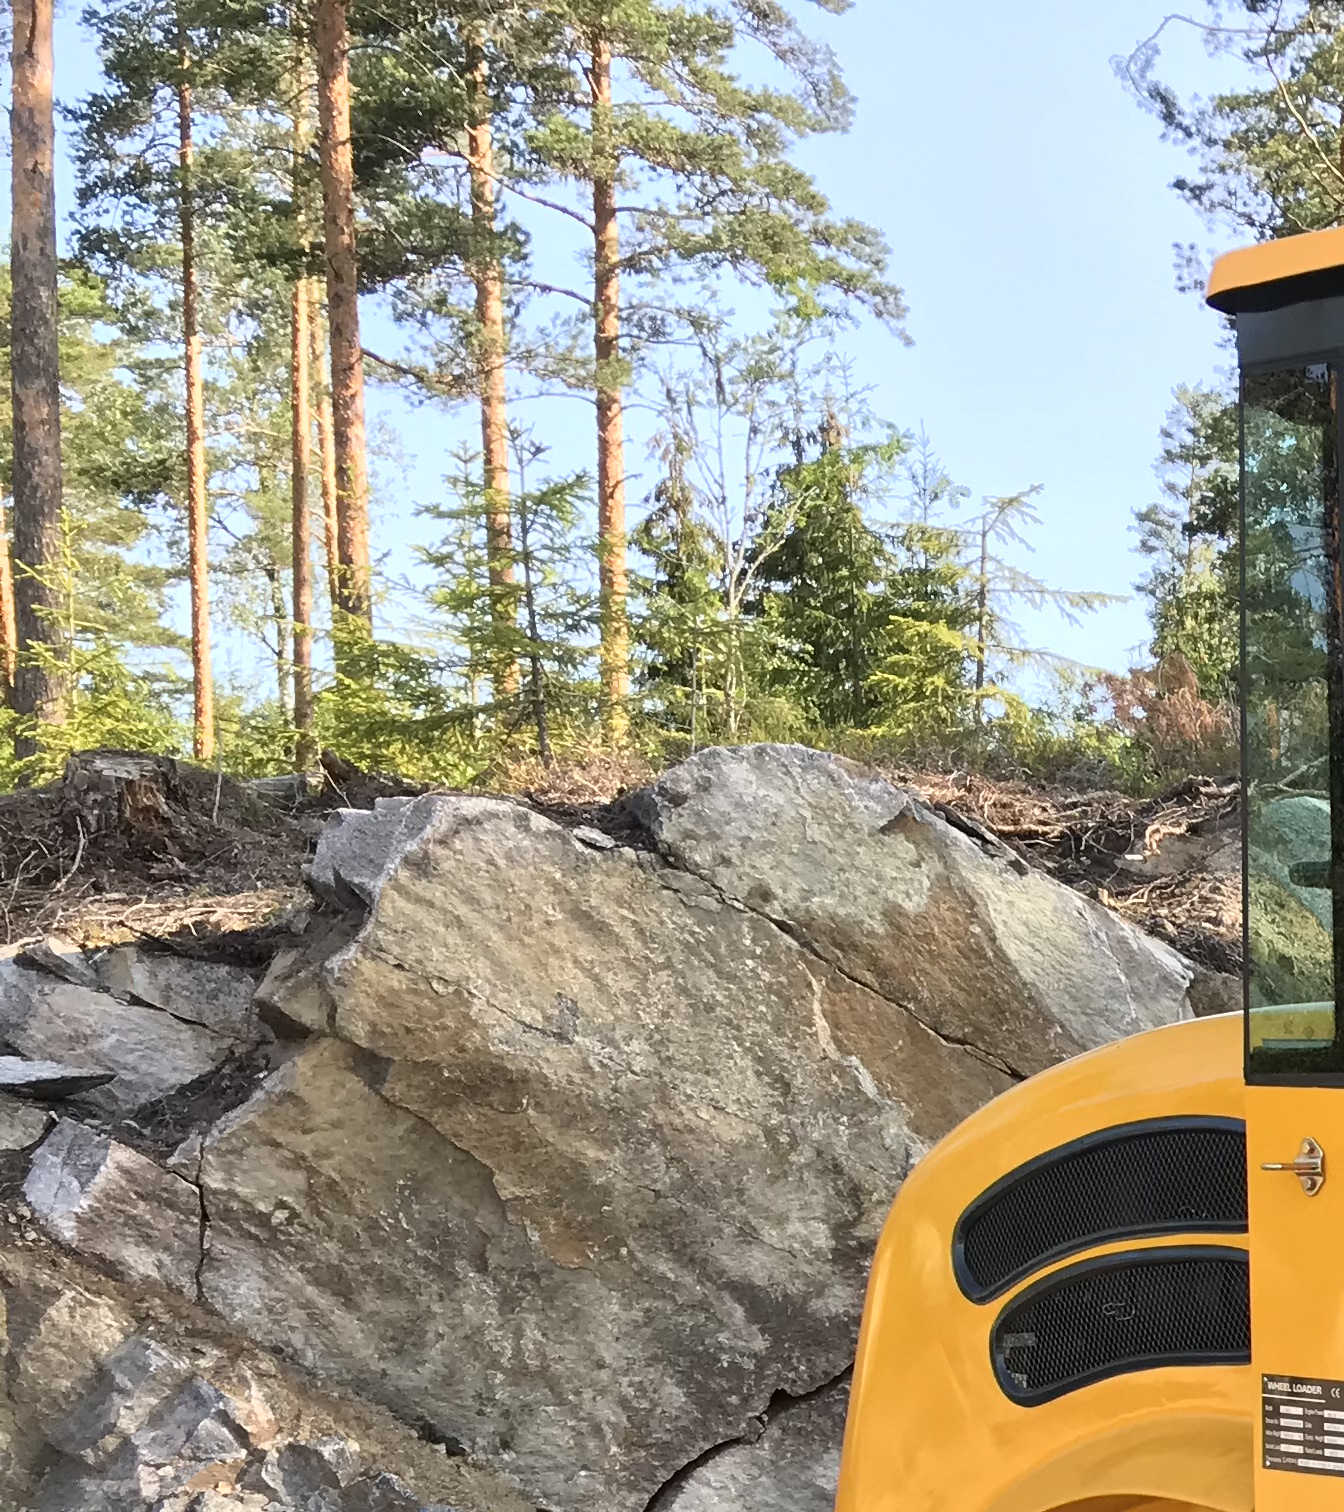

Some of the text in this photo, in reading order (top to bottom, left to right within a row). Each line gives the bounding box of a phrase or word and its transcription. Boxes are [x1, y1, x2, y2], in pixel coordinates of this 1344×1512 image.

[1267, 1382, 1323, 1395] WHEEL LOADER
[1331, 1388, 1341, 1398] CE
